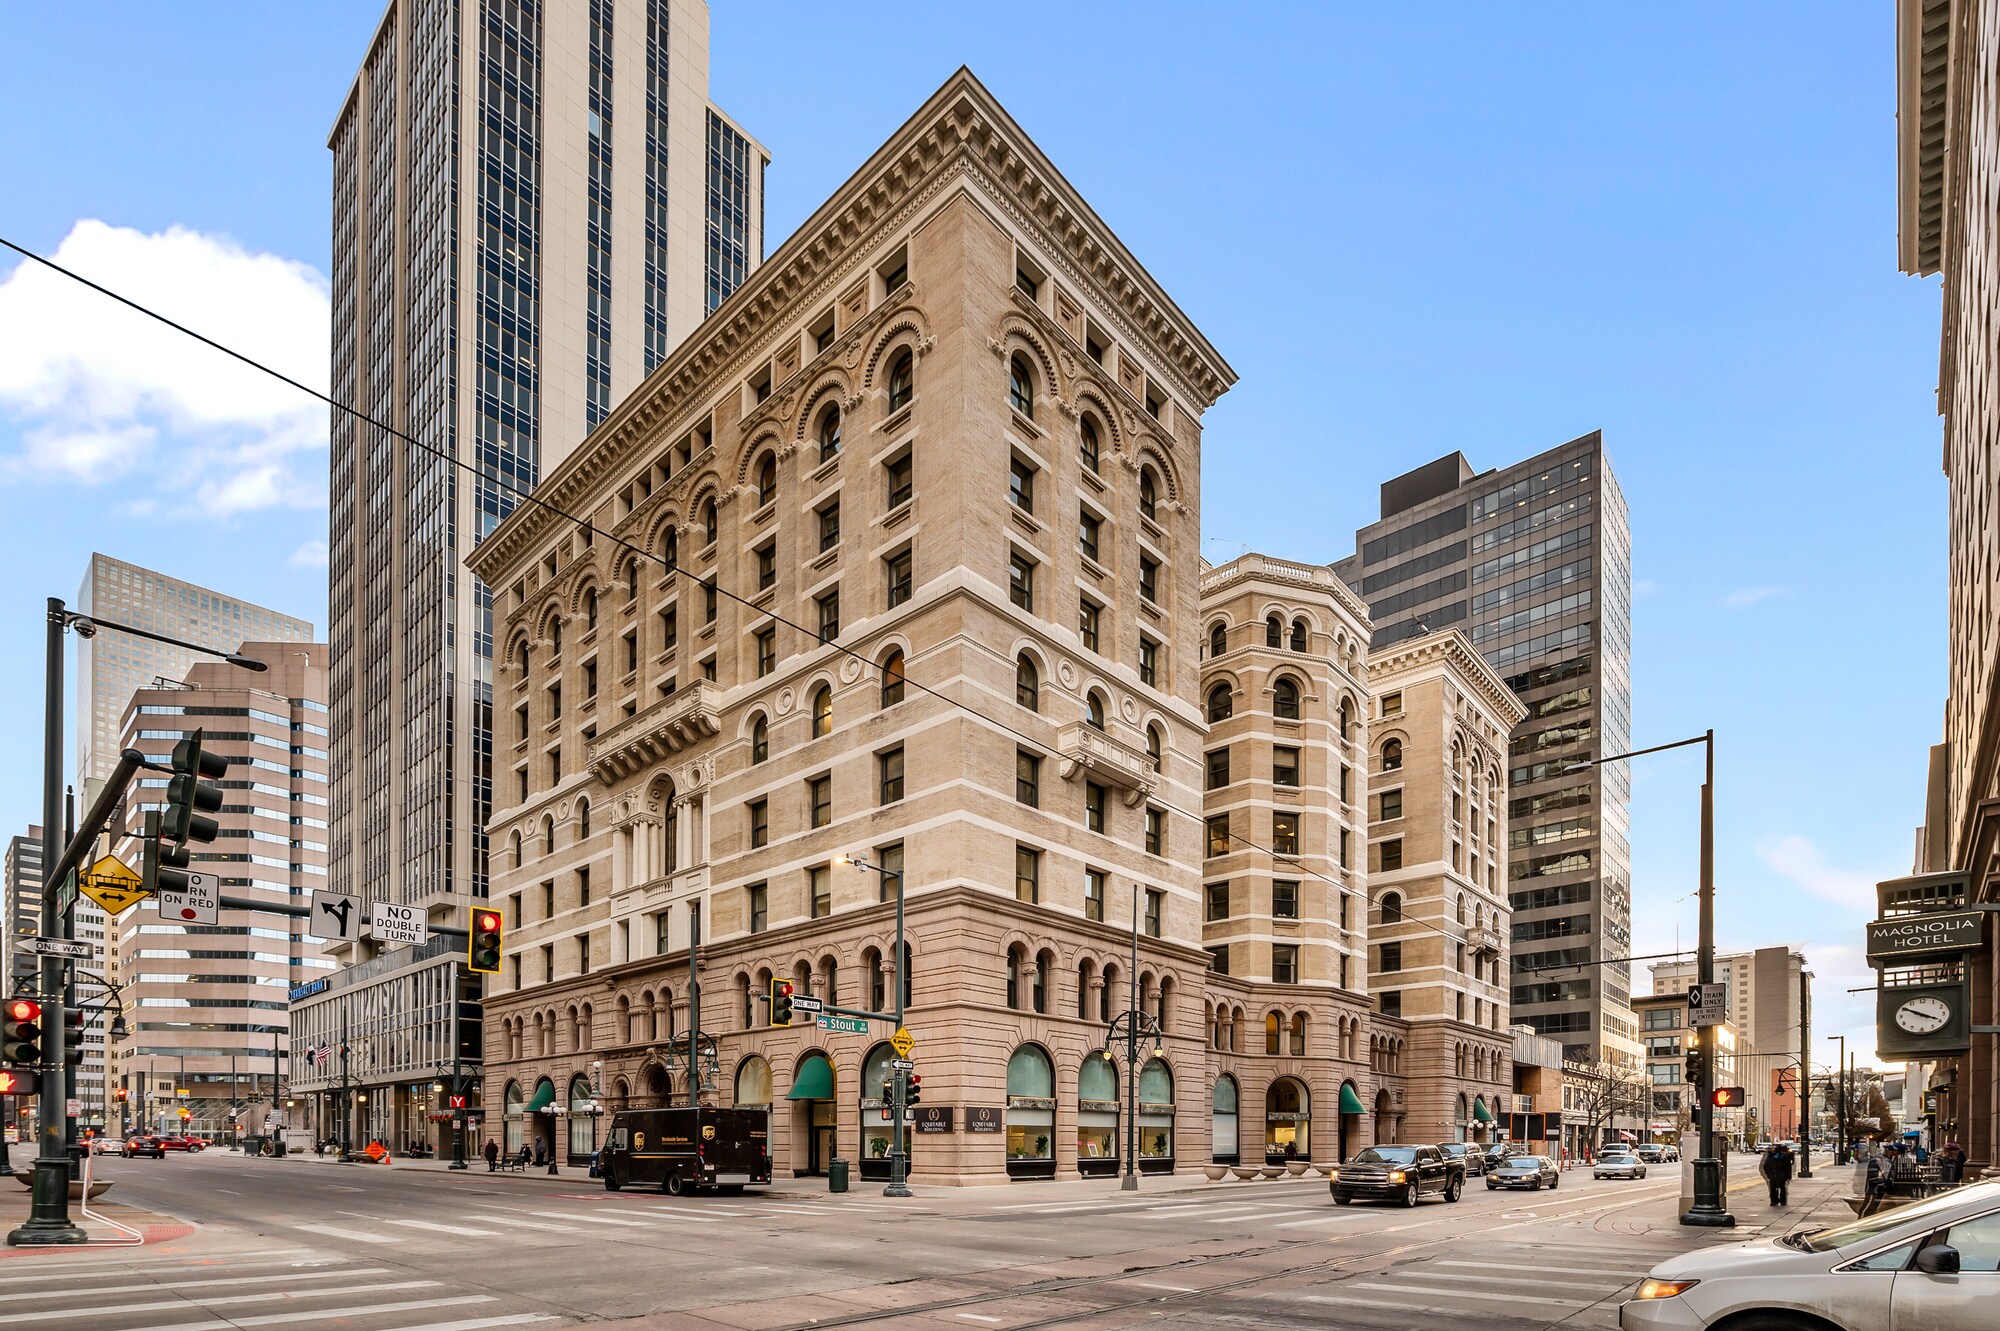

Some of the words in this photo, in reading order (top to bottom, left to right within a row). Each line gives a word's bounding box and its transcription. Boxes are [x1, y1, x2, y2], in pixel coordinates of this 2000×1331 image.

[189, 887, 207, 897] RN
[164, 894, 182, 905] ON
[189, 897, 214, 909] RED
[387, 906, 412, 920] NO
[377, 918, 422, 933] DOUBLE
[1873, 919, 1974, 938] MAGNOLIA
[384, 929, 406, 942] TURN
[1894, 933, 1954, 948] HOTEL
[35, 942, 59, 952] ONE
[62, 945, 85, 954] WAY
[1703, 991, 1724, 999] TRAIN
[793, 999, 805, 1007] ONE
[1704, 998, 1722, 1006] ONLY
[830, 1018, 856, 1031] Stout
[453, 1096, 463, 1107] Y
[931, 1111, 936, 1119] E
[982, 1111, 987, 1119] E
[921, 1121, 947, 1129] EQUITABLE
[972, 1121, 996, 1129] EQUITABLE
[704, 1128, 715, 1139] ups
[635, 1137, 644, 1149] ups
